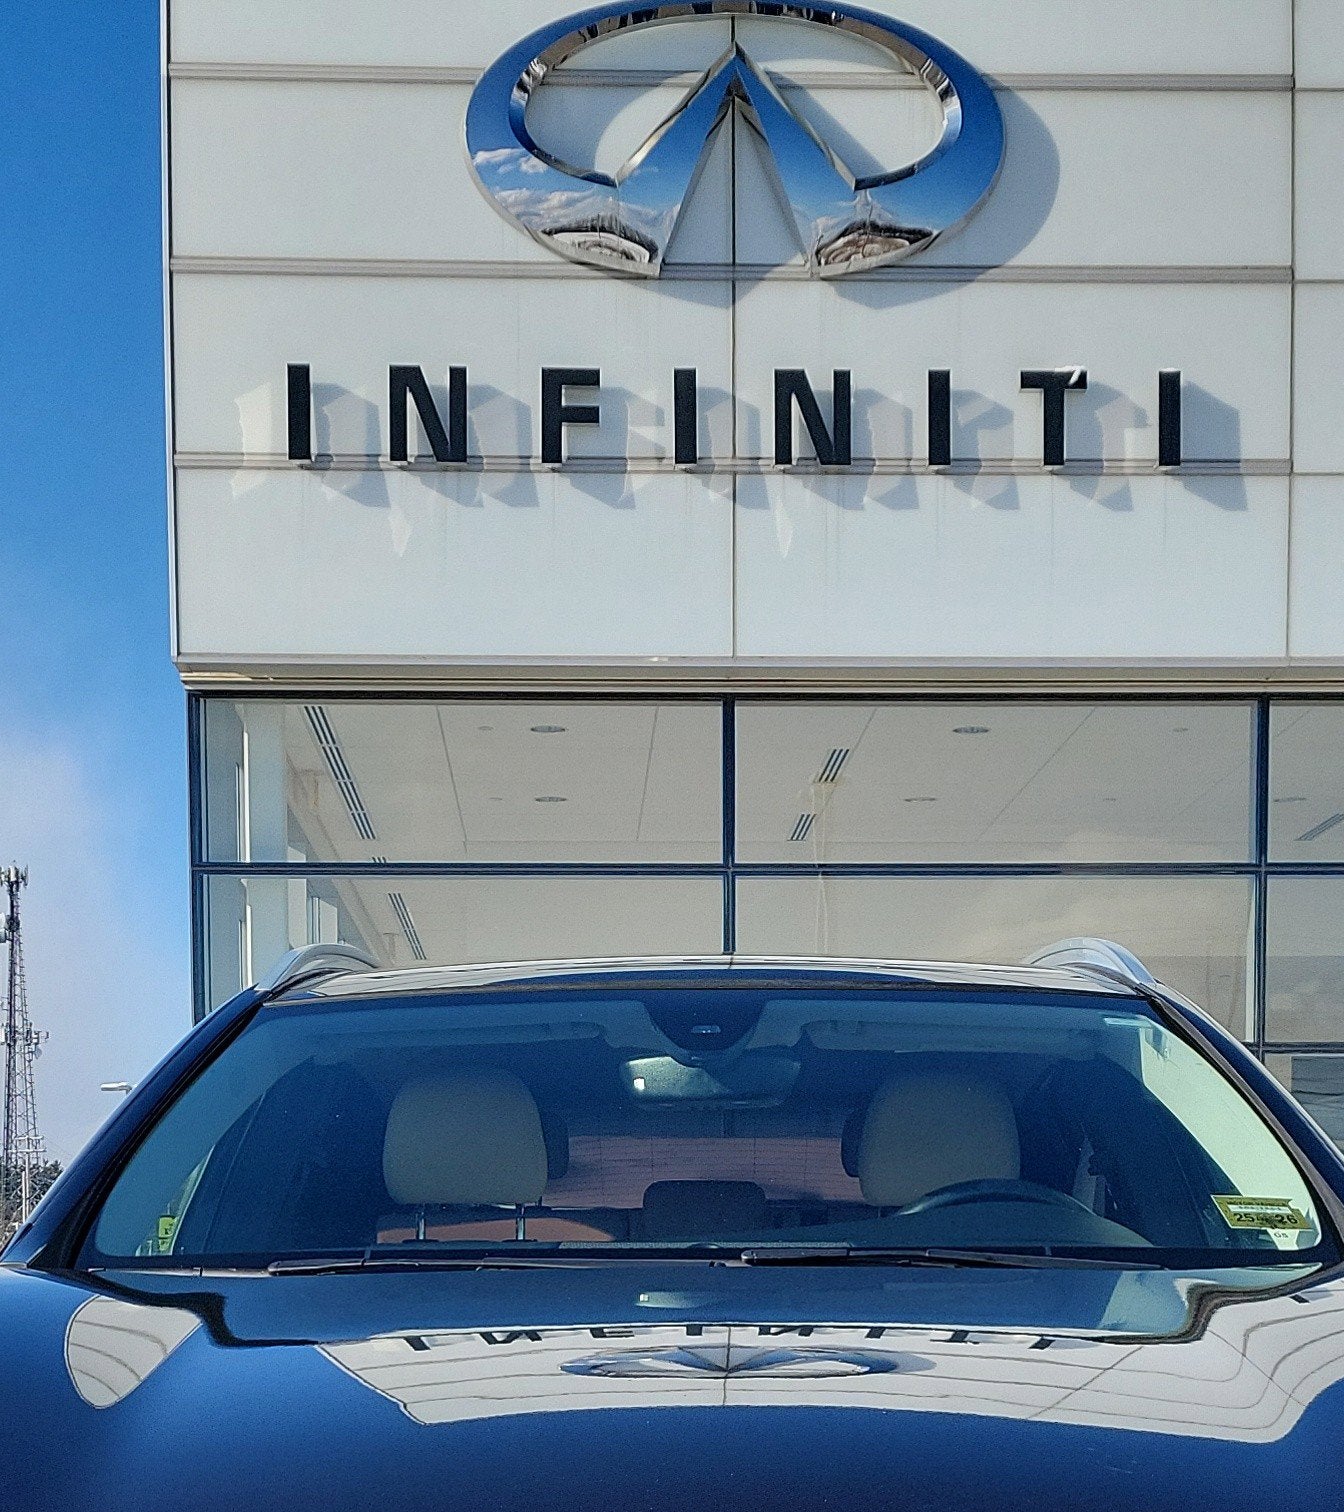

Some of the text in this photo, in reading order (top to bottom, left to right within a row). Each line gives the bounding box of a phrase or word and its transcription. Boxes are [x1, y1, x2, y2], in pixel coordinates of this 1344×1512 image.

[286, 363, 1183, 466] INFINITI
[1234, 1212, 1255, 1222] 25
[1274, 1213, 1299, 1224] 26
